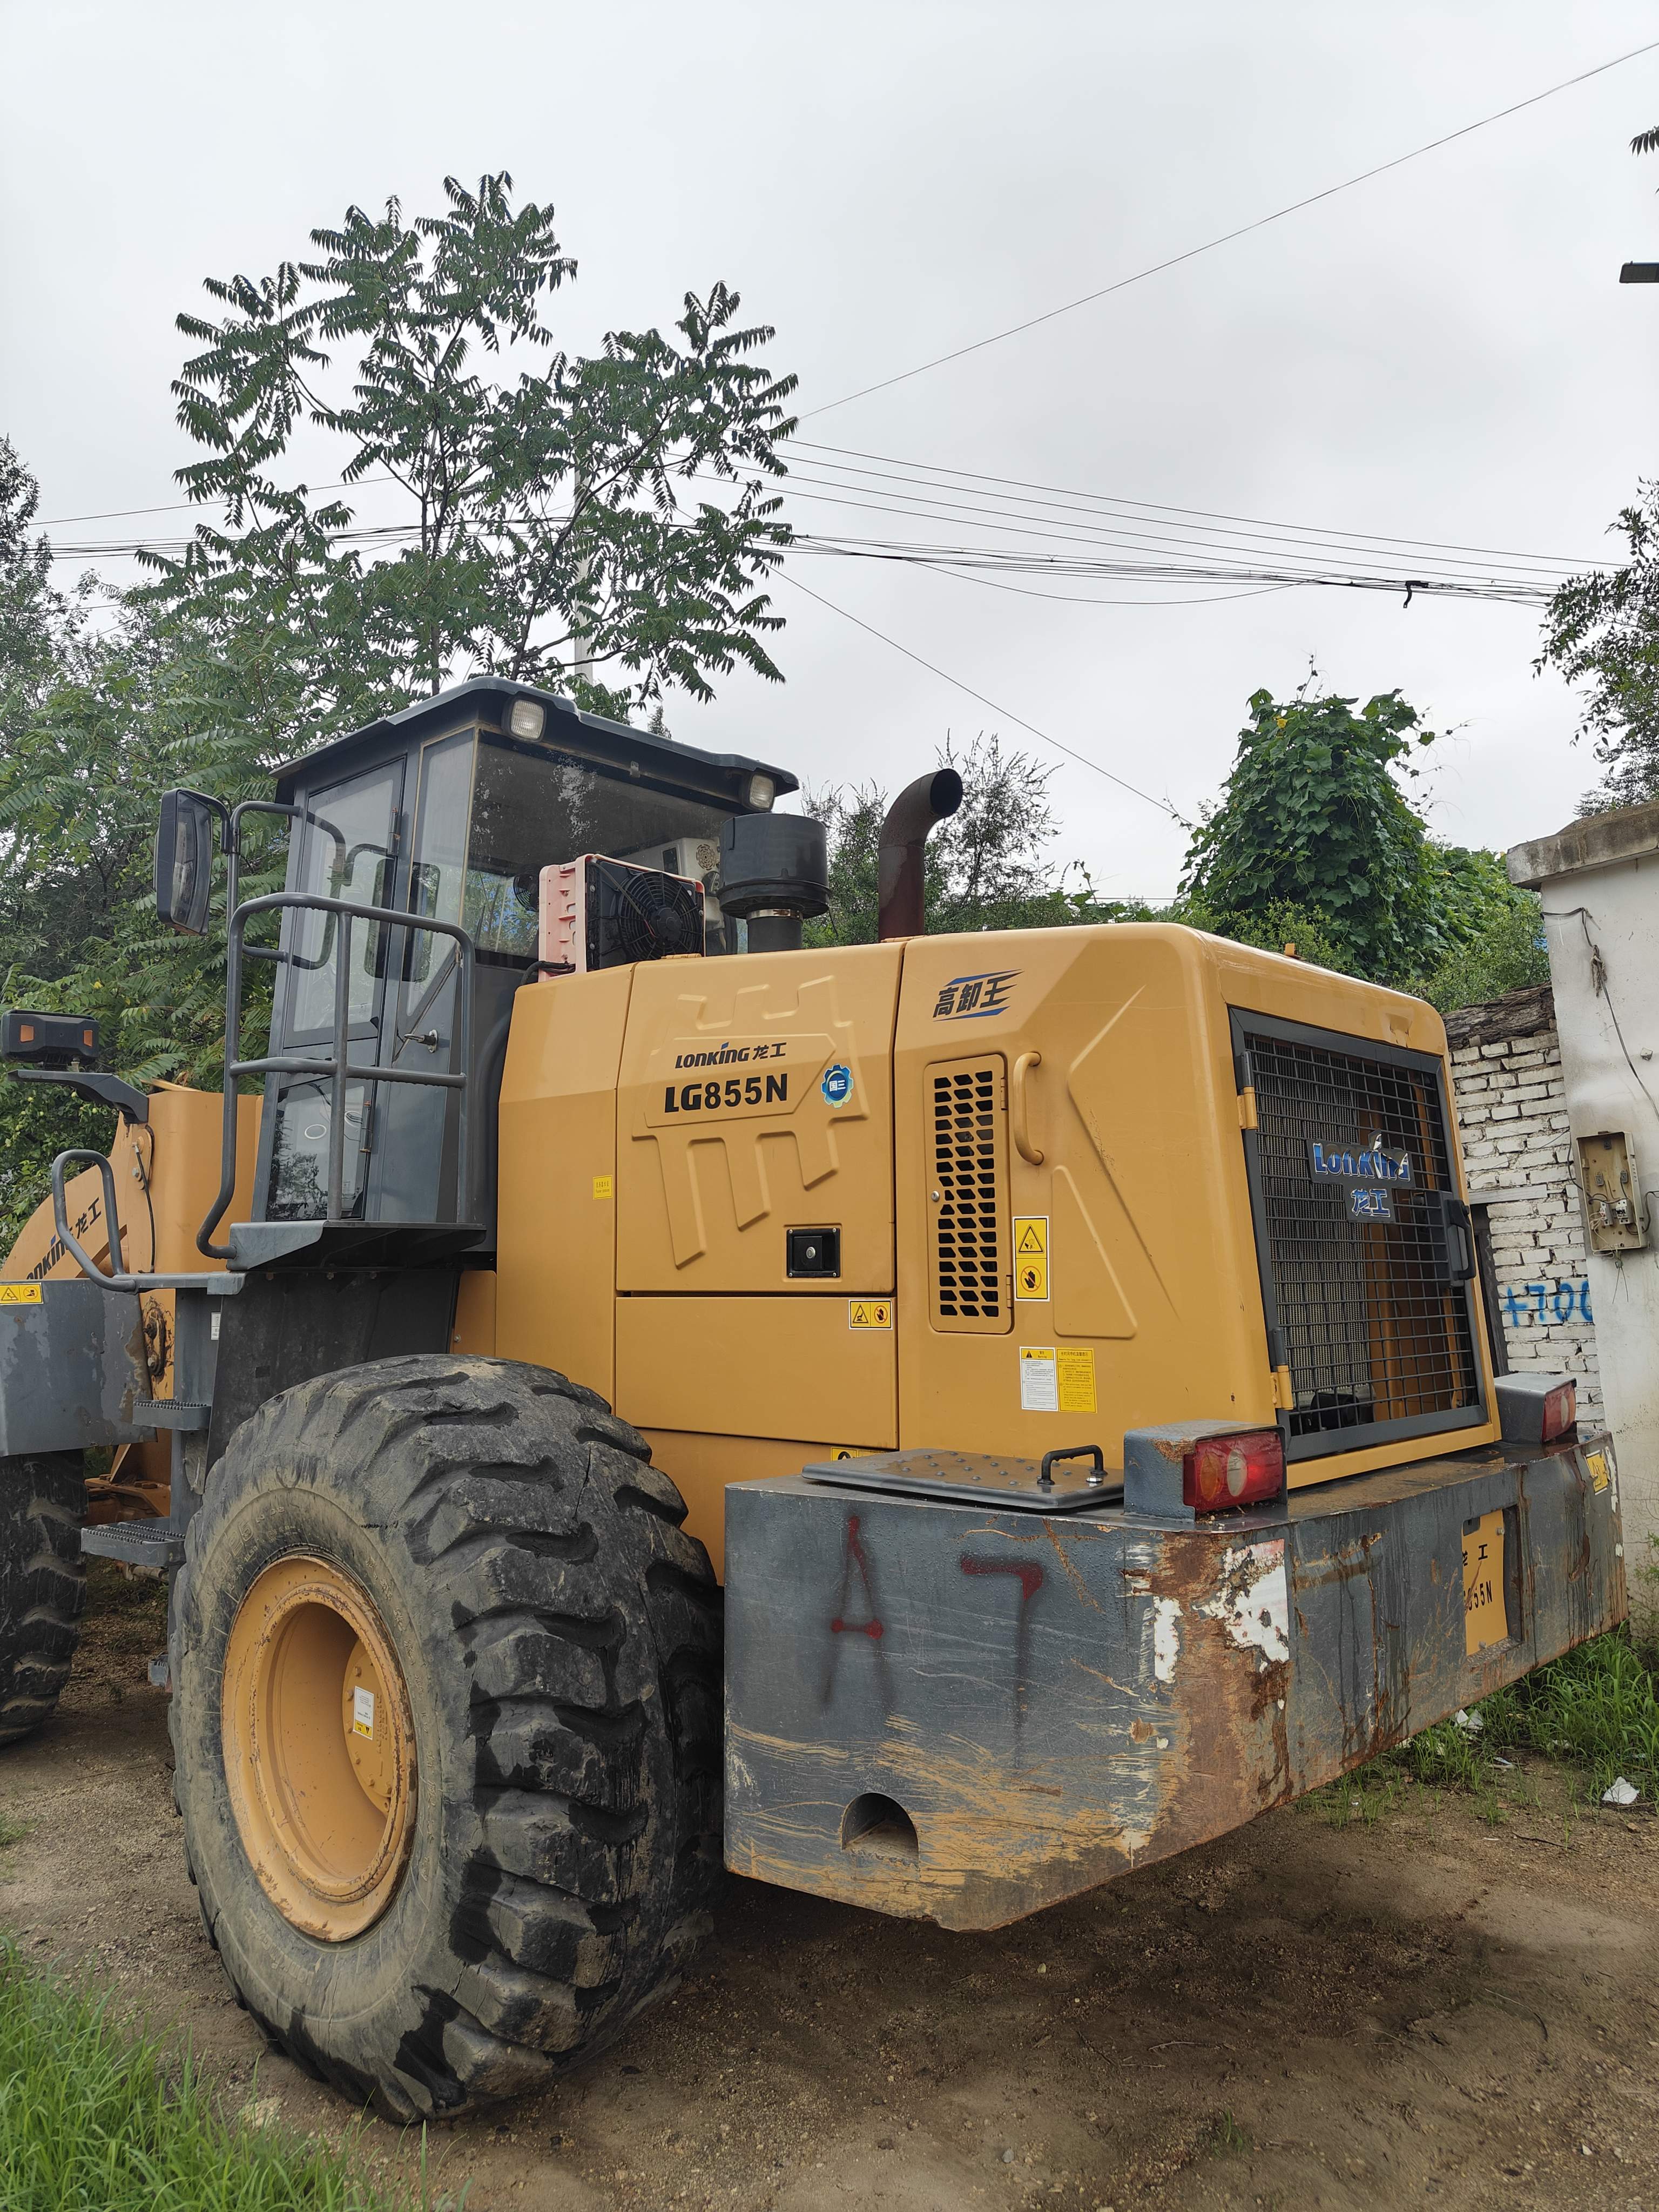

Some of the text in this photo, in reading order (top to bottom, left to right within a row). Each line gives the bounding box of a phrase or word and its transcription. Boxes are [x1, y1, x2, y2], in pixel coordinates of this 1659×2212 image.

[932, 971, 1024, 1018] 高卸王
[752, 1042, 787, 1060] 龙工
[664, 1073, 788, 1113] LG855N
[1351, 1188, 1391, 1218] 龙工
